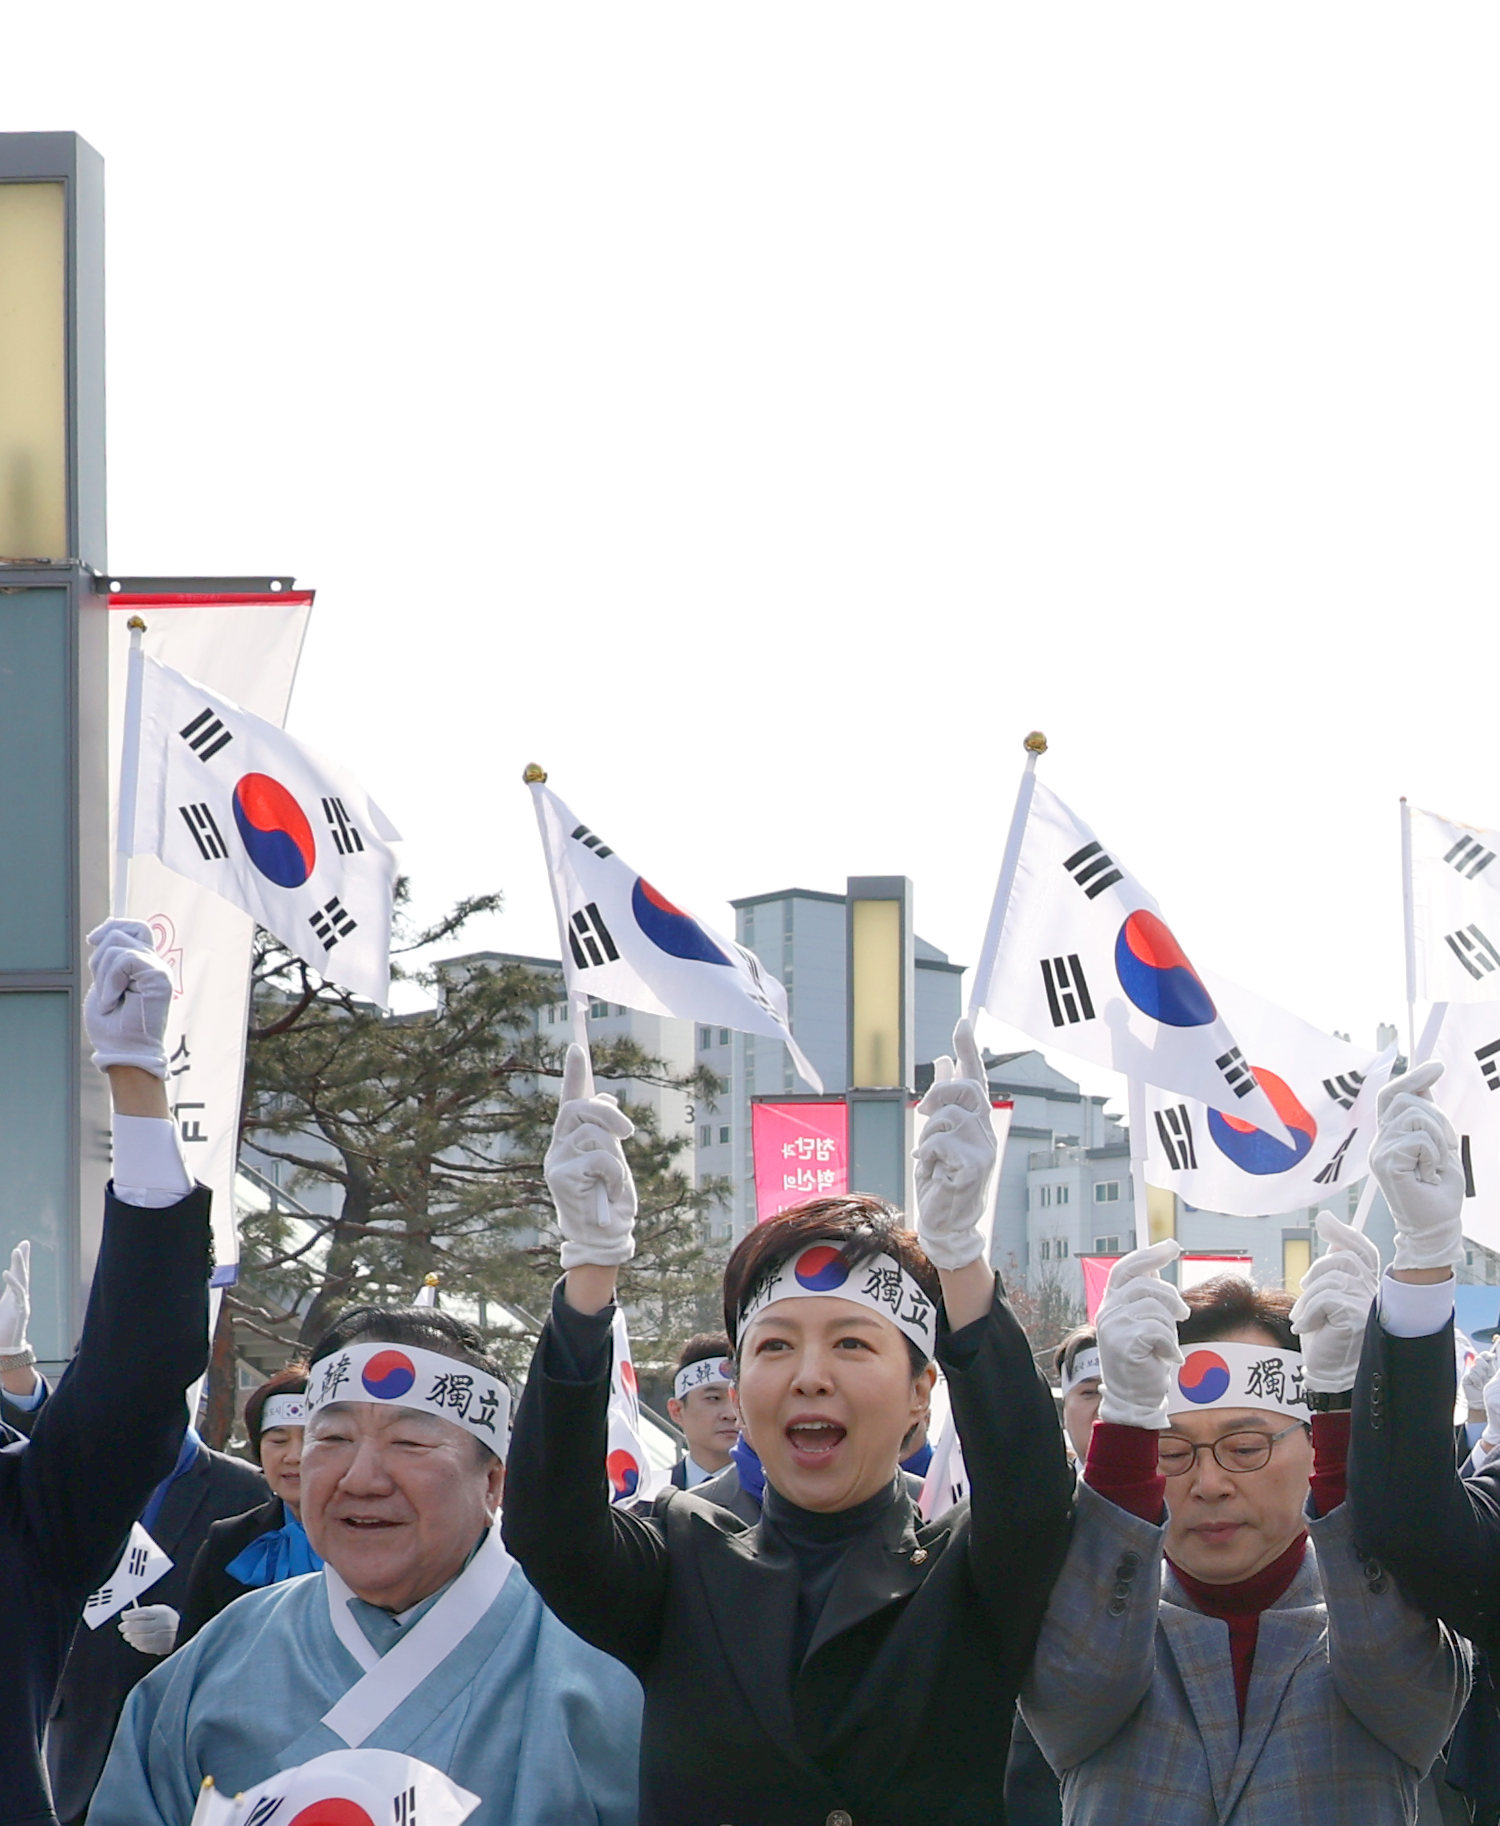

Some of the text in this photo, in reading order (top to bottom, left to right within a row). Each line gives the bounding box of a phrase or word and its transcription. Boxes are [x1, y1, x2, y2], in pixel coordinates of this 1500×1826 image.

[861, 1266, 931, 1336] 獨立
[425, 1373, 500, 1434] 獨立
[681, 1362, 715, 1392] 大韓
